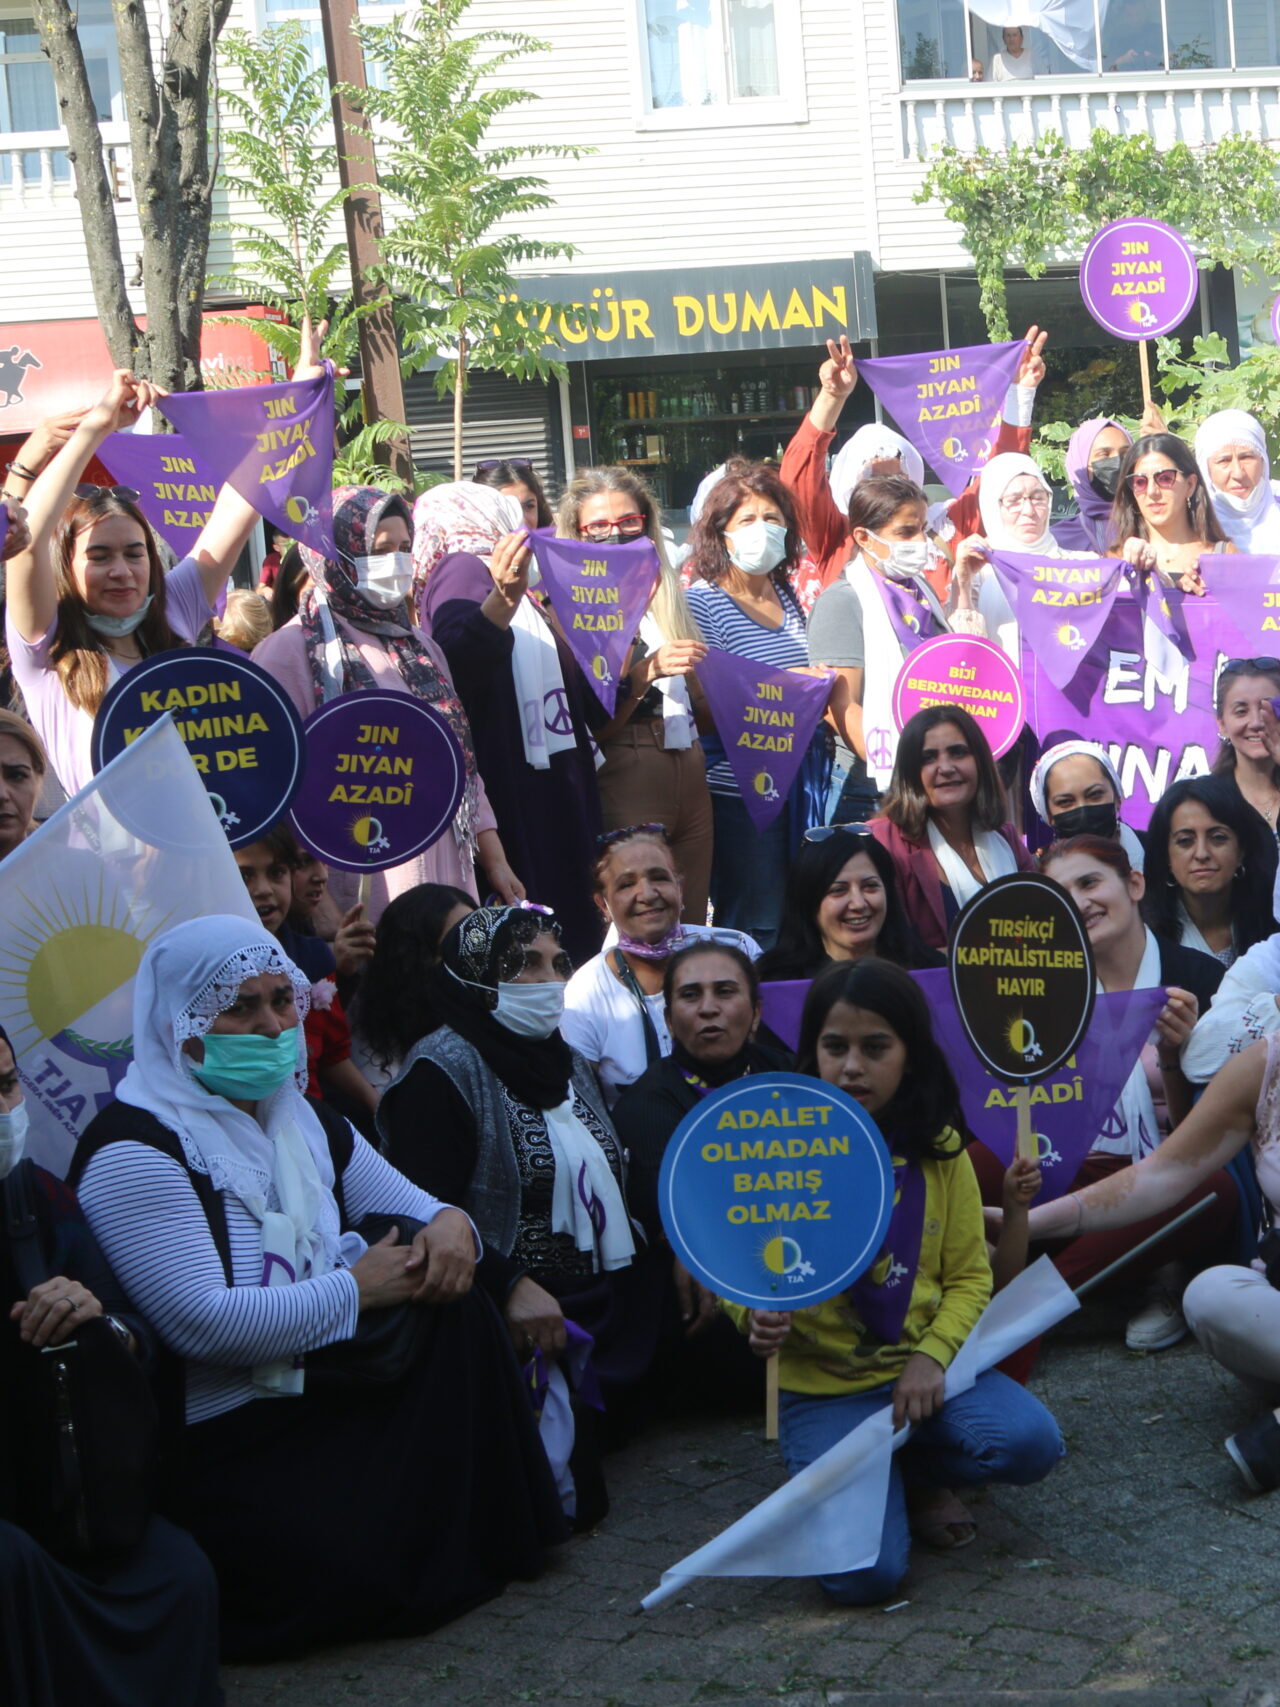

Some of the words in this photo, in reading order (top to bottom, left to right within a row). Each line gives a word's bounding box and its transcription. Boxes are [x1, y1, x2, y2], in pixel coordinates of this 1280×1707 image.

[1121, 241, 1149, 255] JIN
[1111, 260, 1162, 276] JIYAN
[1111, 279, 1166, 296] AZADÎ
[673, 285, 848, 337] DUMAN
[929, 354, 961, 374] JIN
[916, 375, 976, 399] JIYAN
[263, 396, 297, 419] JIN
[918, 393, 980, 423] AZADÎ
[160, 456, 197, 474] JIN
[153, 482, 216, 502] JIYAN
[581, 559, 607, 577] JIN
[1033, 566, 1101, 584] JIYAN
[571, 585, 620, 605] JIYAN
[1031, 585, 1104, 607] AZADÎ
[572, 608, 624, 631] AZADÎ
[756, 682, 783, 702] JIN
[907, 678, 1015, 704] BERXWEDANA
[1103, 650, 1190, 714] EM
[140, 681, 242, 712] KADIN
[743, 705, 795, 727] JIYAN
[356, 724, 399, 745] JIN
[736, 732, 793, 753] AZADÎ
[216, 747, 259, 772] DE
[335, 752, 413, 776] JIYAN
[328, 782, 414, 806] AZADÎ
[957, 942, 1084, 969] KAPİTALİSTLERE
[997, 977, 1046, 996] HAYIR
[34, 1057, 87, 1124] TJA
[716, 1105, 833, 1130] ADALET
[701, 1136, 850, 1163] OLMADAN
[733, 1169, 823, 1194] BARIŞ
[726, 1200, 831, 1225] OLMAZ
